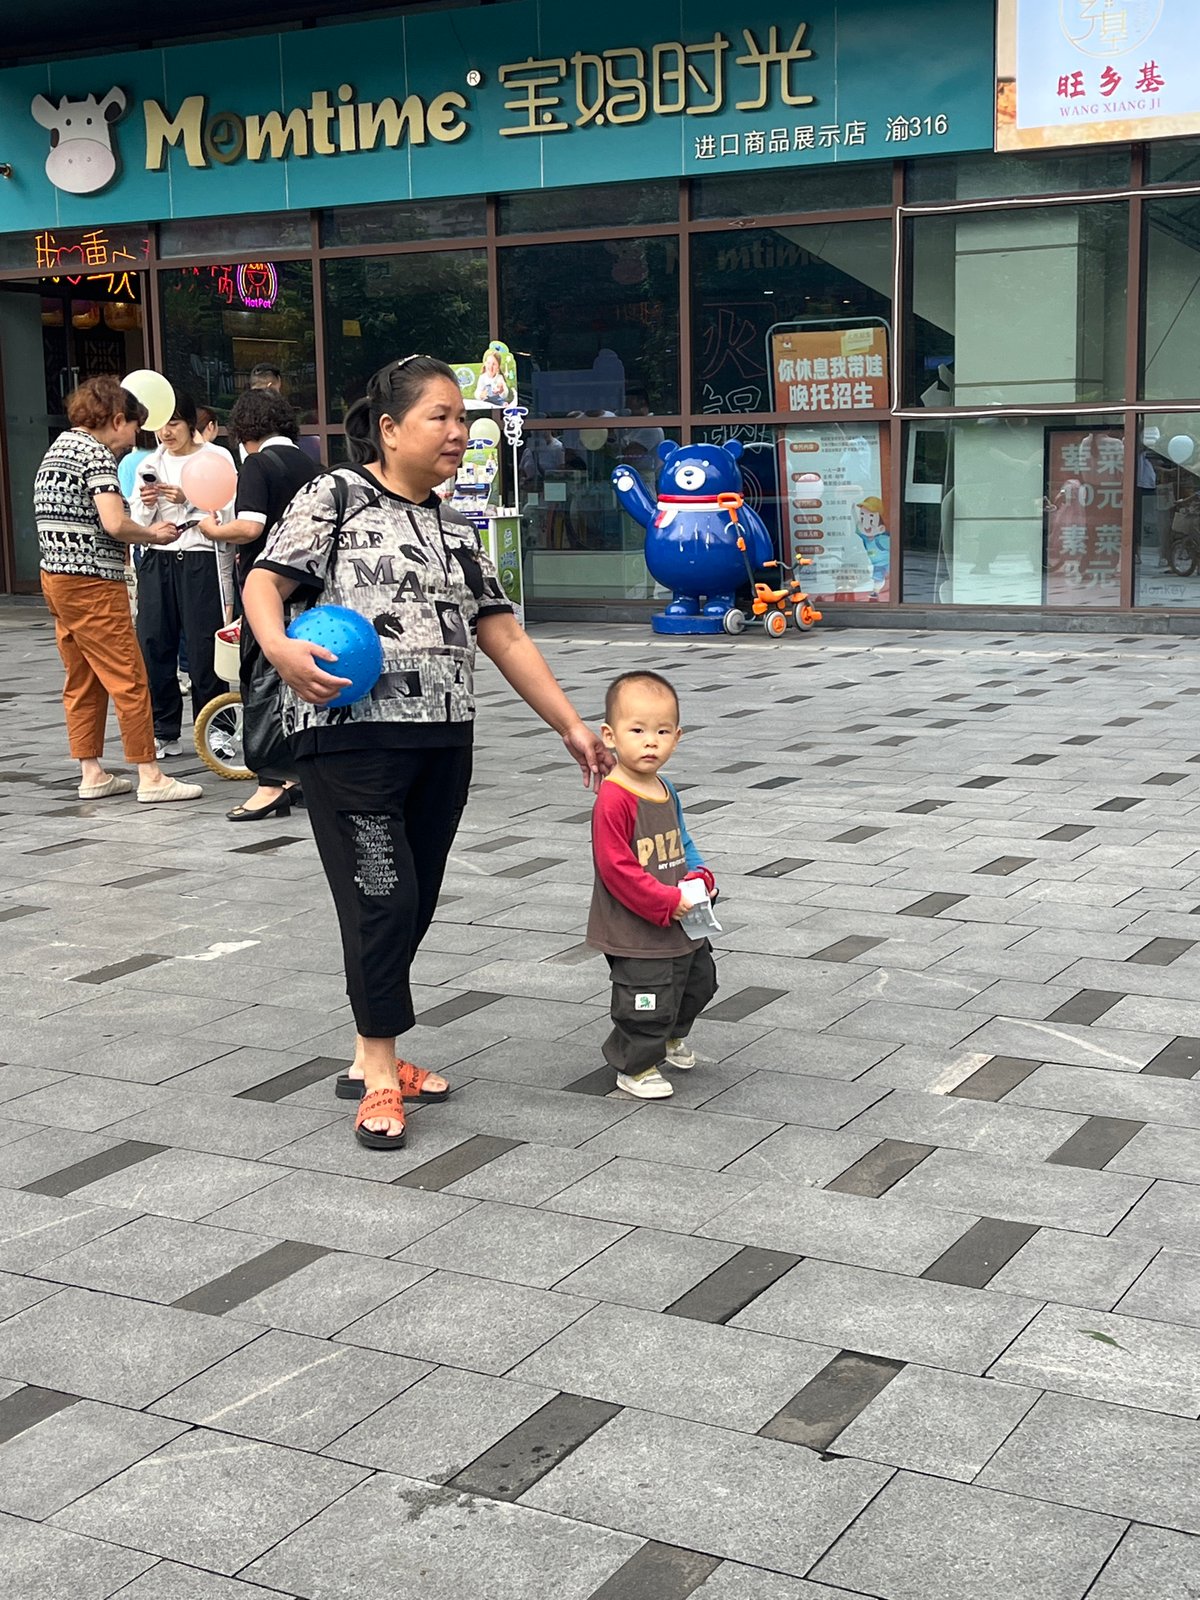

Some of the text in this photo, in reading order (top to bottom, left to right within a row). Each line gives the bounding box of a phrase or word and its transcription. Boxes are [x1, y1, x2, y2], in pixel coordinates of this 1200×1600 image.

[499, 22, 813, 135] 宝妈时光
[1056, 60, 1165, 98] 旺乡基
[1060, 98, 1161, 117] WANG XIANG JI
[143, 84, 466, 169] Momtime
[694, 114, 948, 159] 进口商品展示店 渝316
[778, 354, 883, 382] 你休息我带娃
[789, 381, 875, 411] 晚托招生
[1061, 443, 1124, 475] 荤菜
[1062, 482, 1123, 509] 10元
[1060, 525, 1122, 556] 素菜
